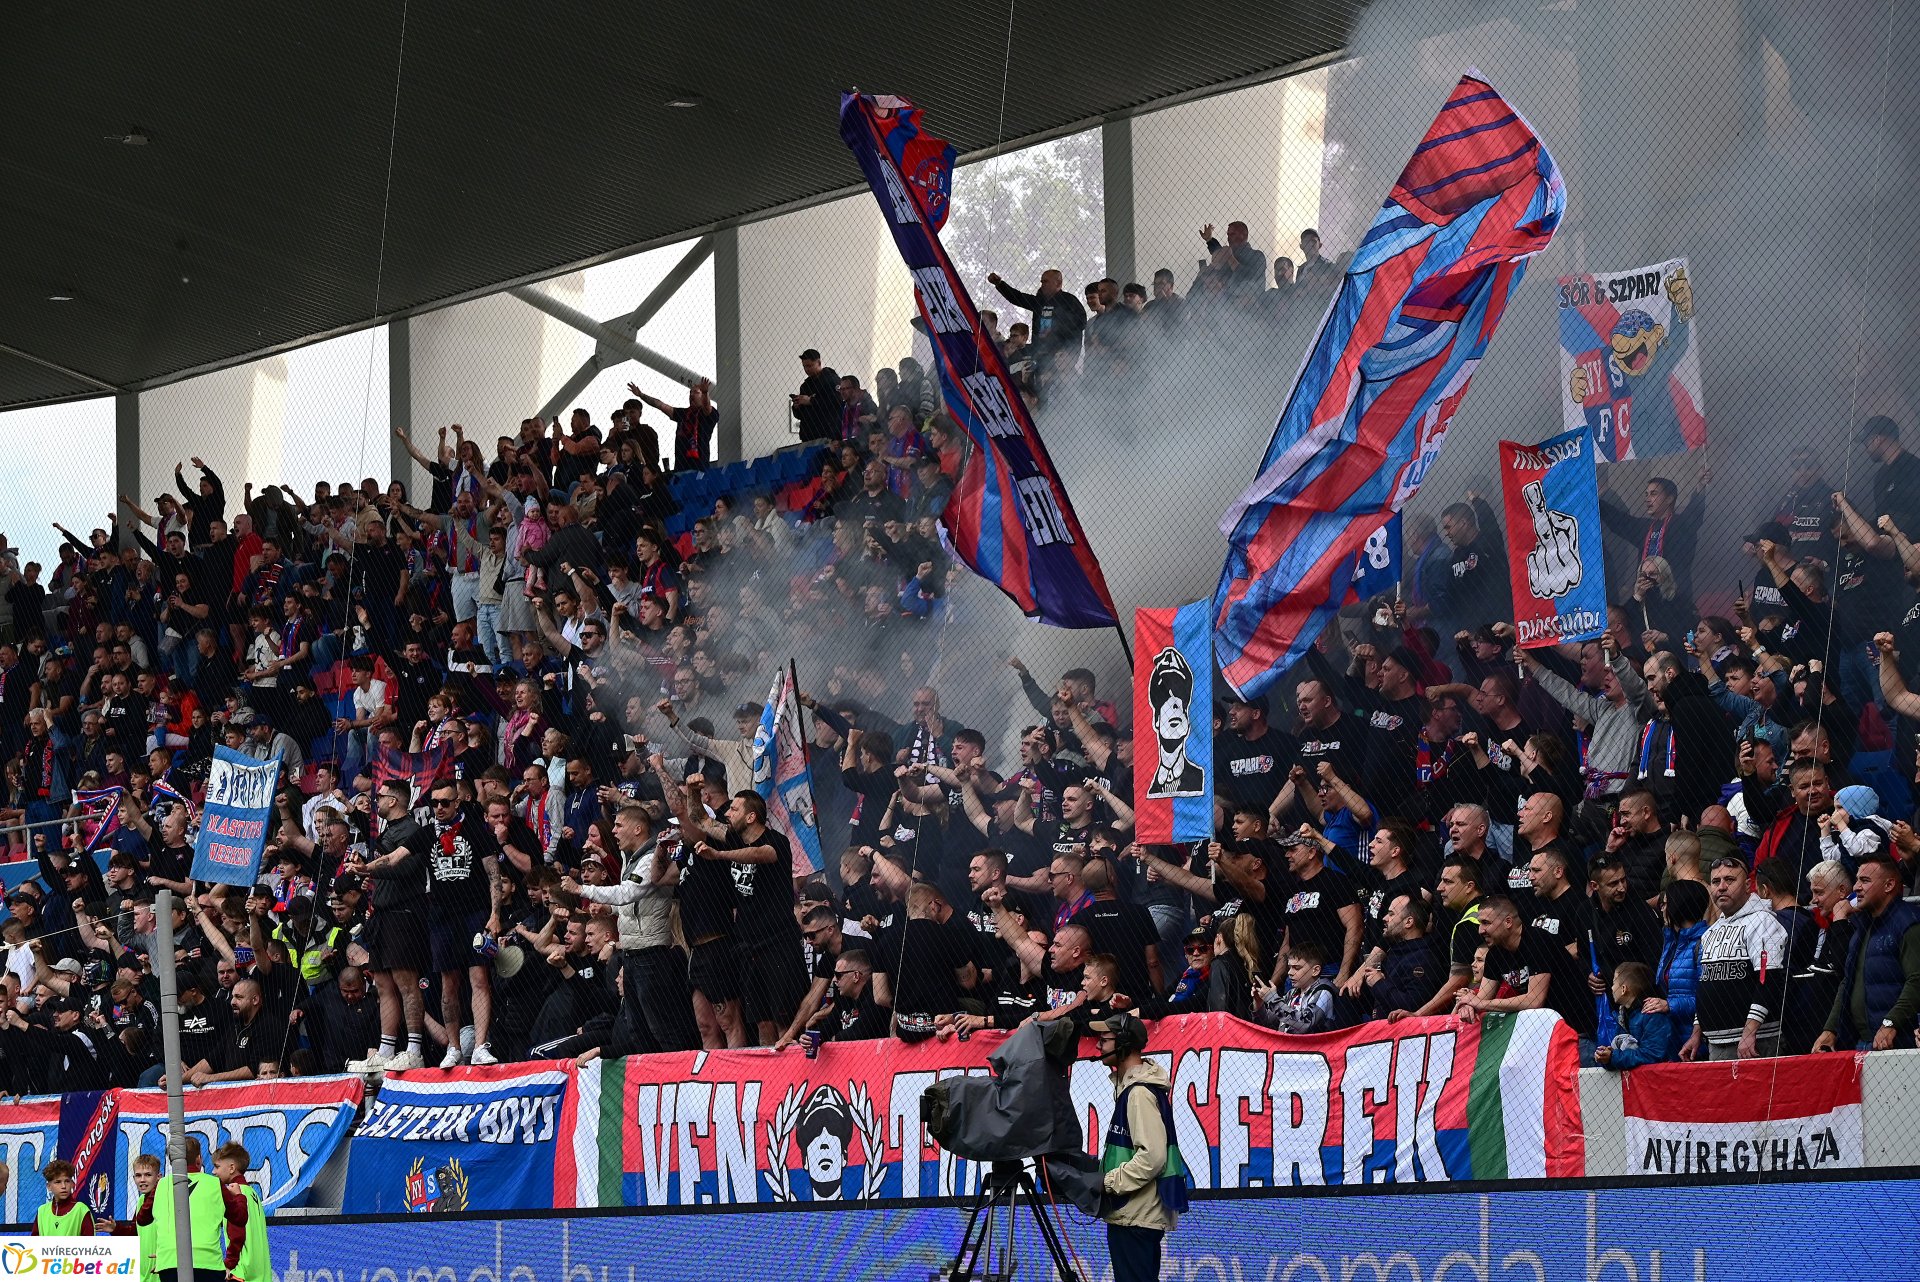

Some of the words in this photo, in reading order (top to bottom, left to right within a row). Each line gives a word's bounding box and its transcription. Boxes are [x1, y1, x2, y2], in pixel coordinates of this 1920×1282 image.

[1558, 276, 1591, 310] SÖR
[1608, 271, 1662, 303] SZPARI
[1598, 408, 1612, 443] F
[1617, 402, 1630, 438] C
[353, 1099, 484, 1143] EASTERN
[477, 1094, 561, 1144] BOYS
[637, 1051, 762, 1206] VÉN
[426, 1174, 436, 1194] S
